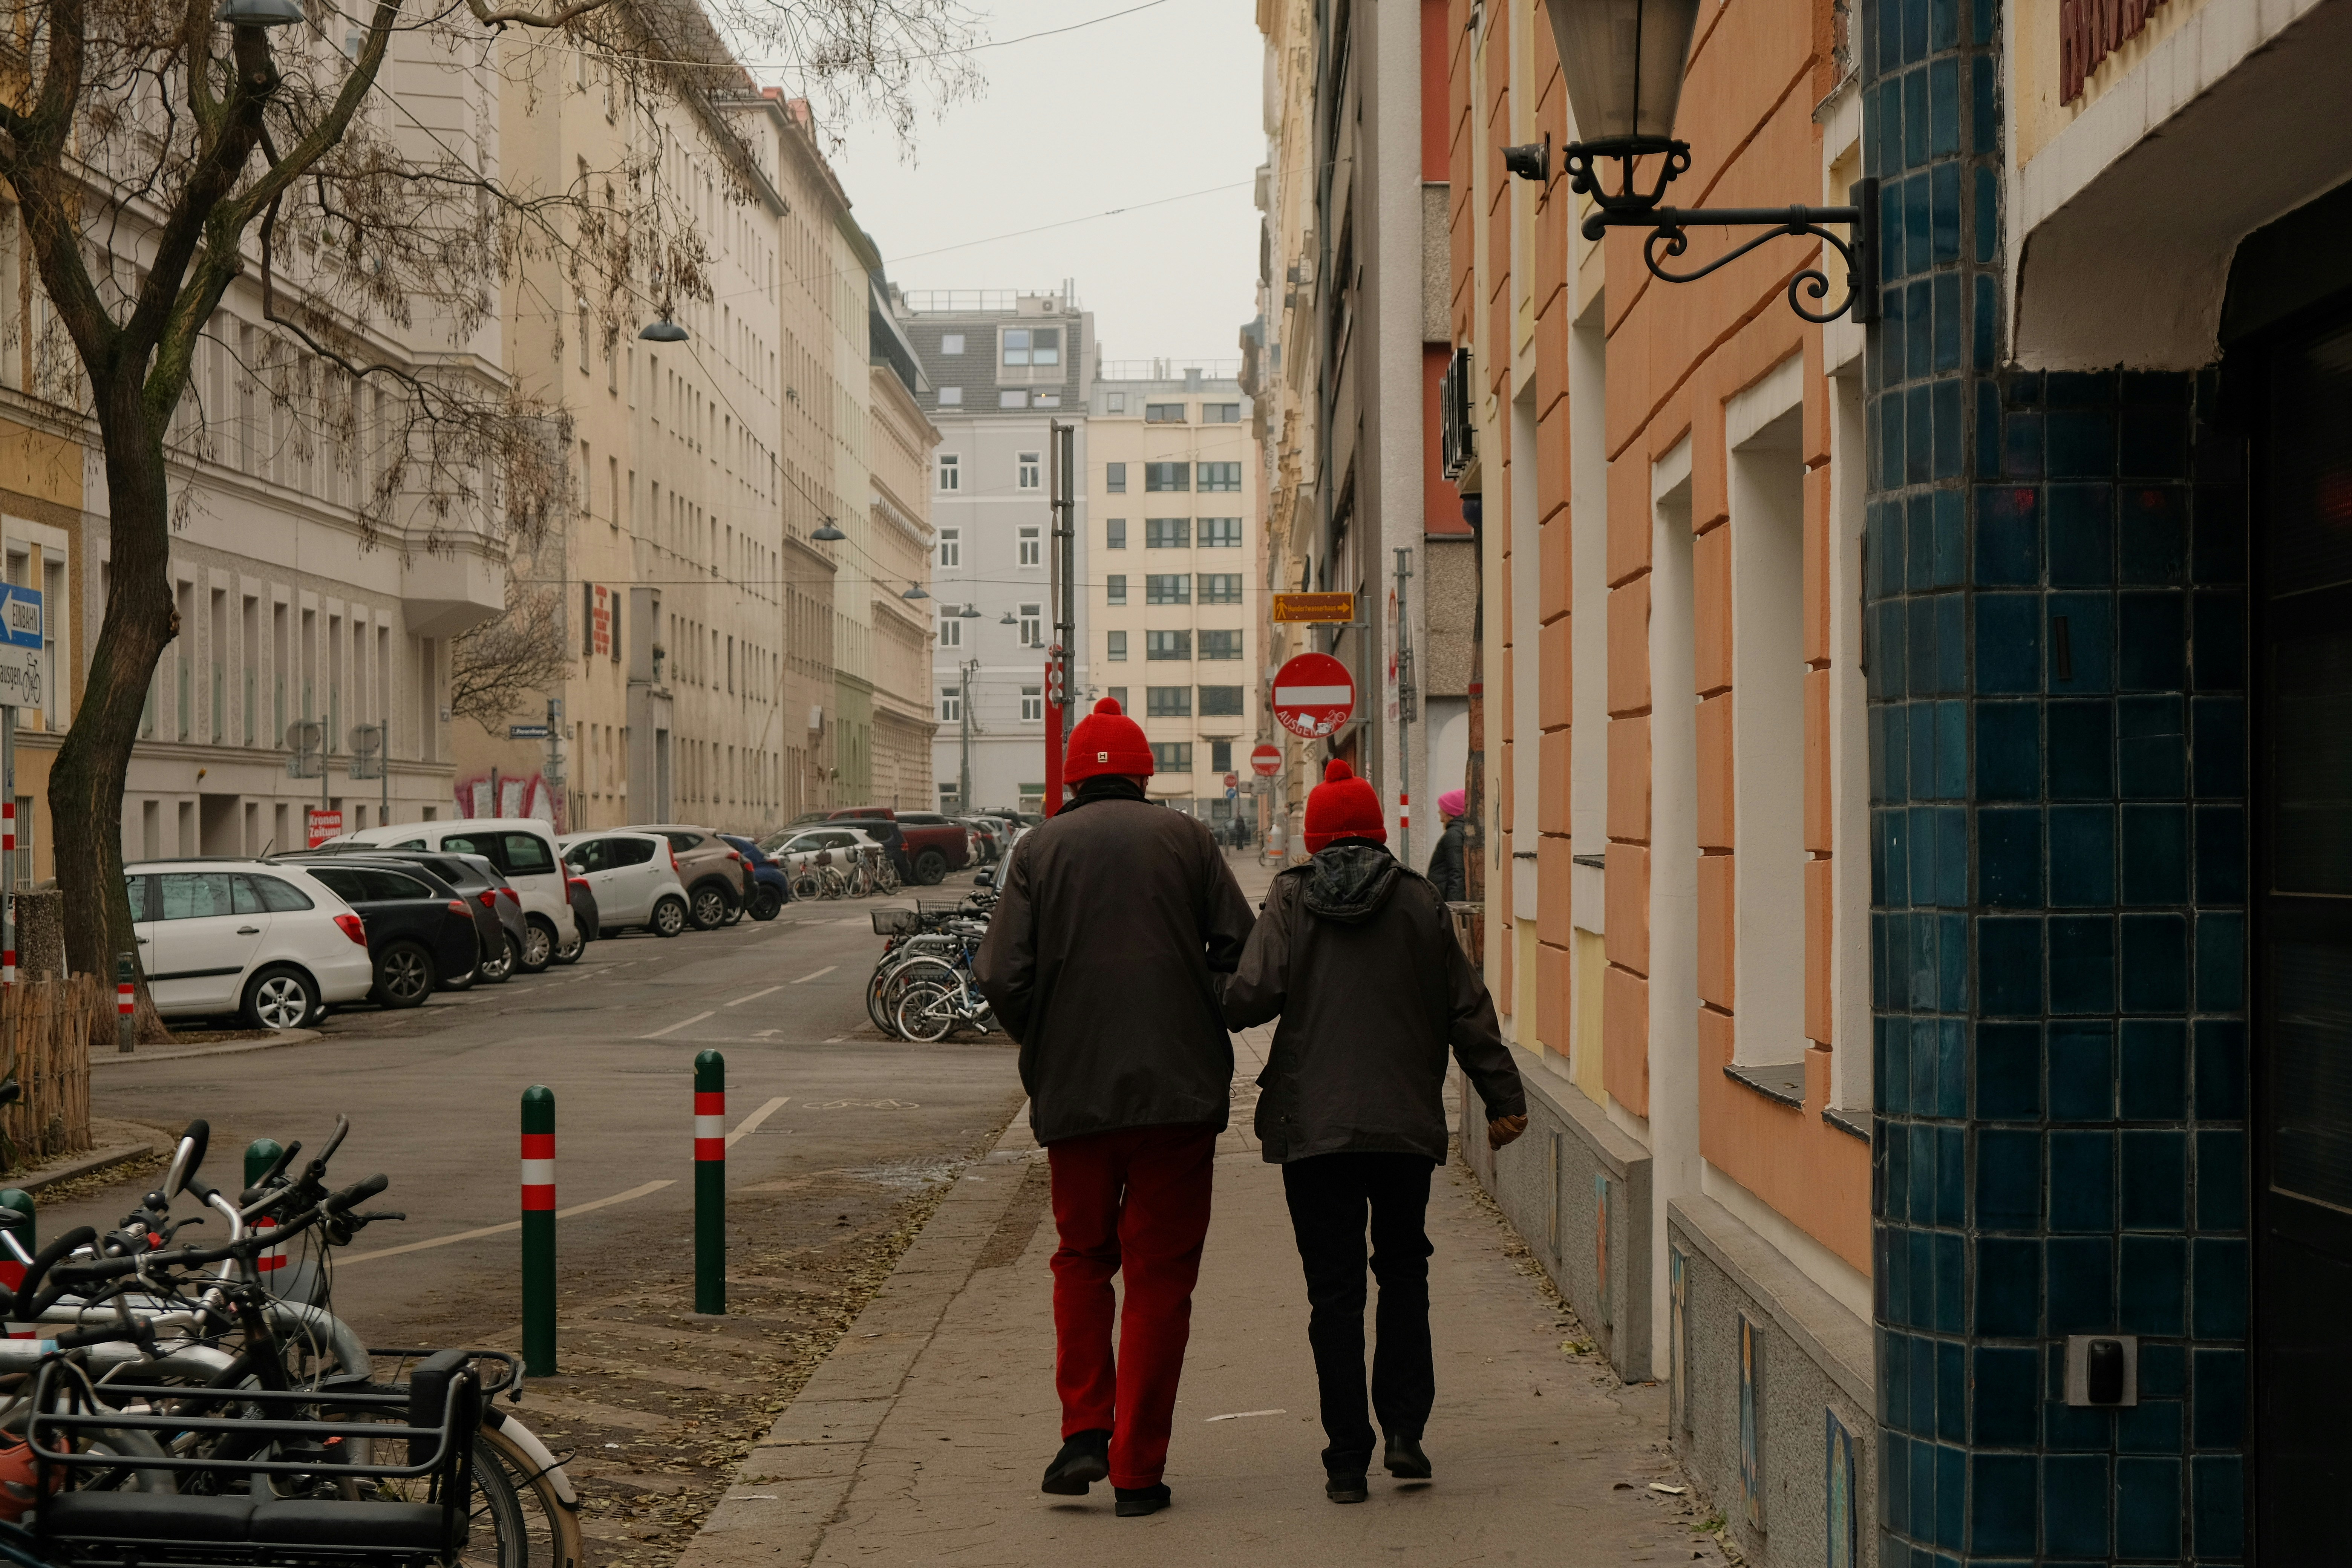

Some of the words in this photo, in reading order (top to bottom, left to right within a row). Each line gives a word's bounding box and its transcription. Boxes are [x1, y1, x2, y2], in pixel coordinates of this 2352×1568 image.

[13, 603, 37, 631] EINBAHN
[0, 665, 22, 690] ausgen.
[309, 815, 340, 825] Kronen
[309, 827, 341, 837] Zeitung
